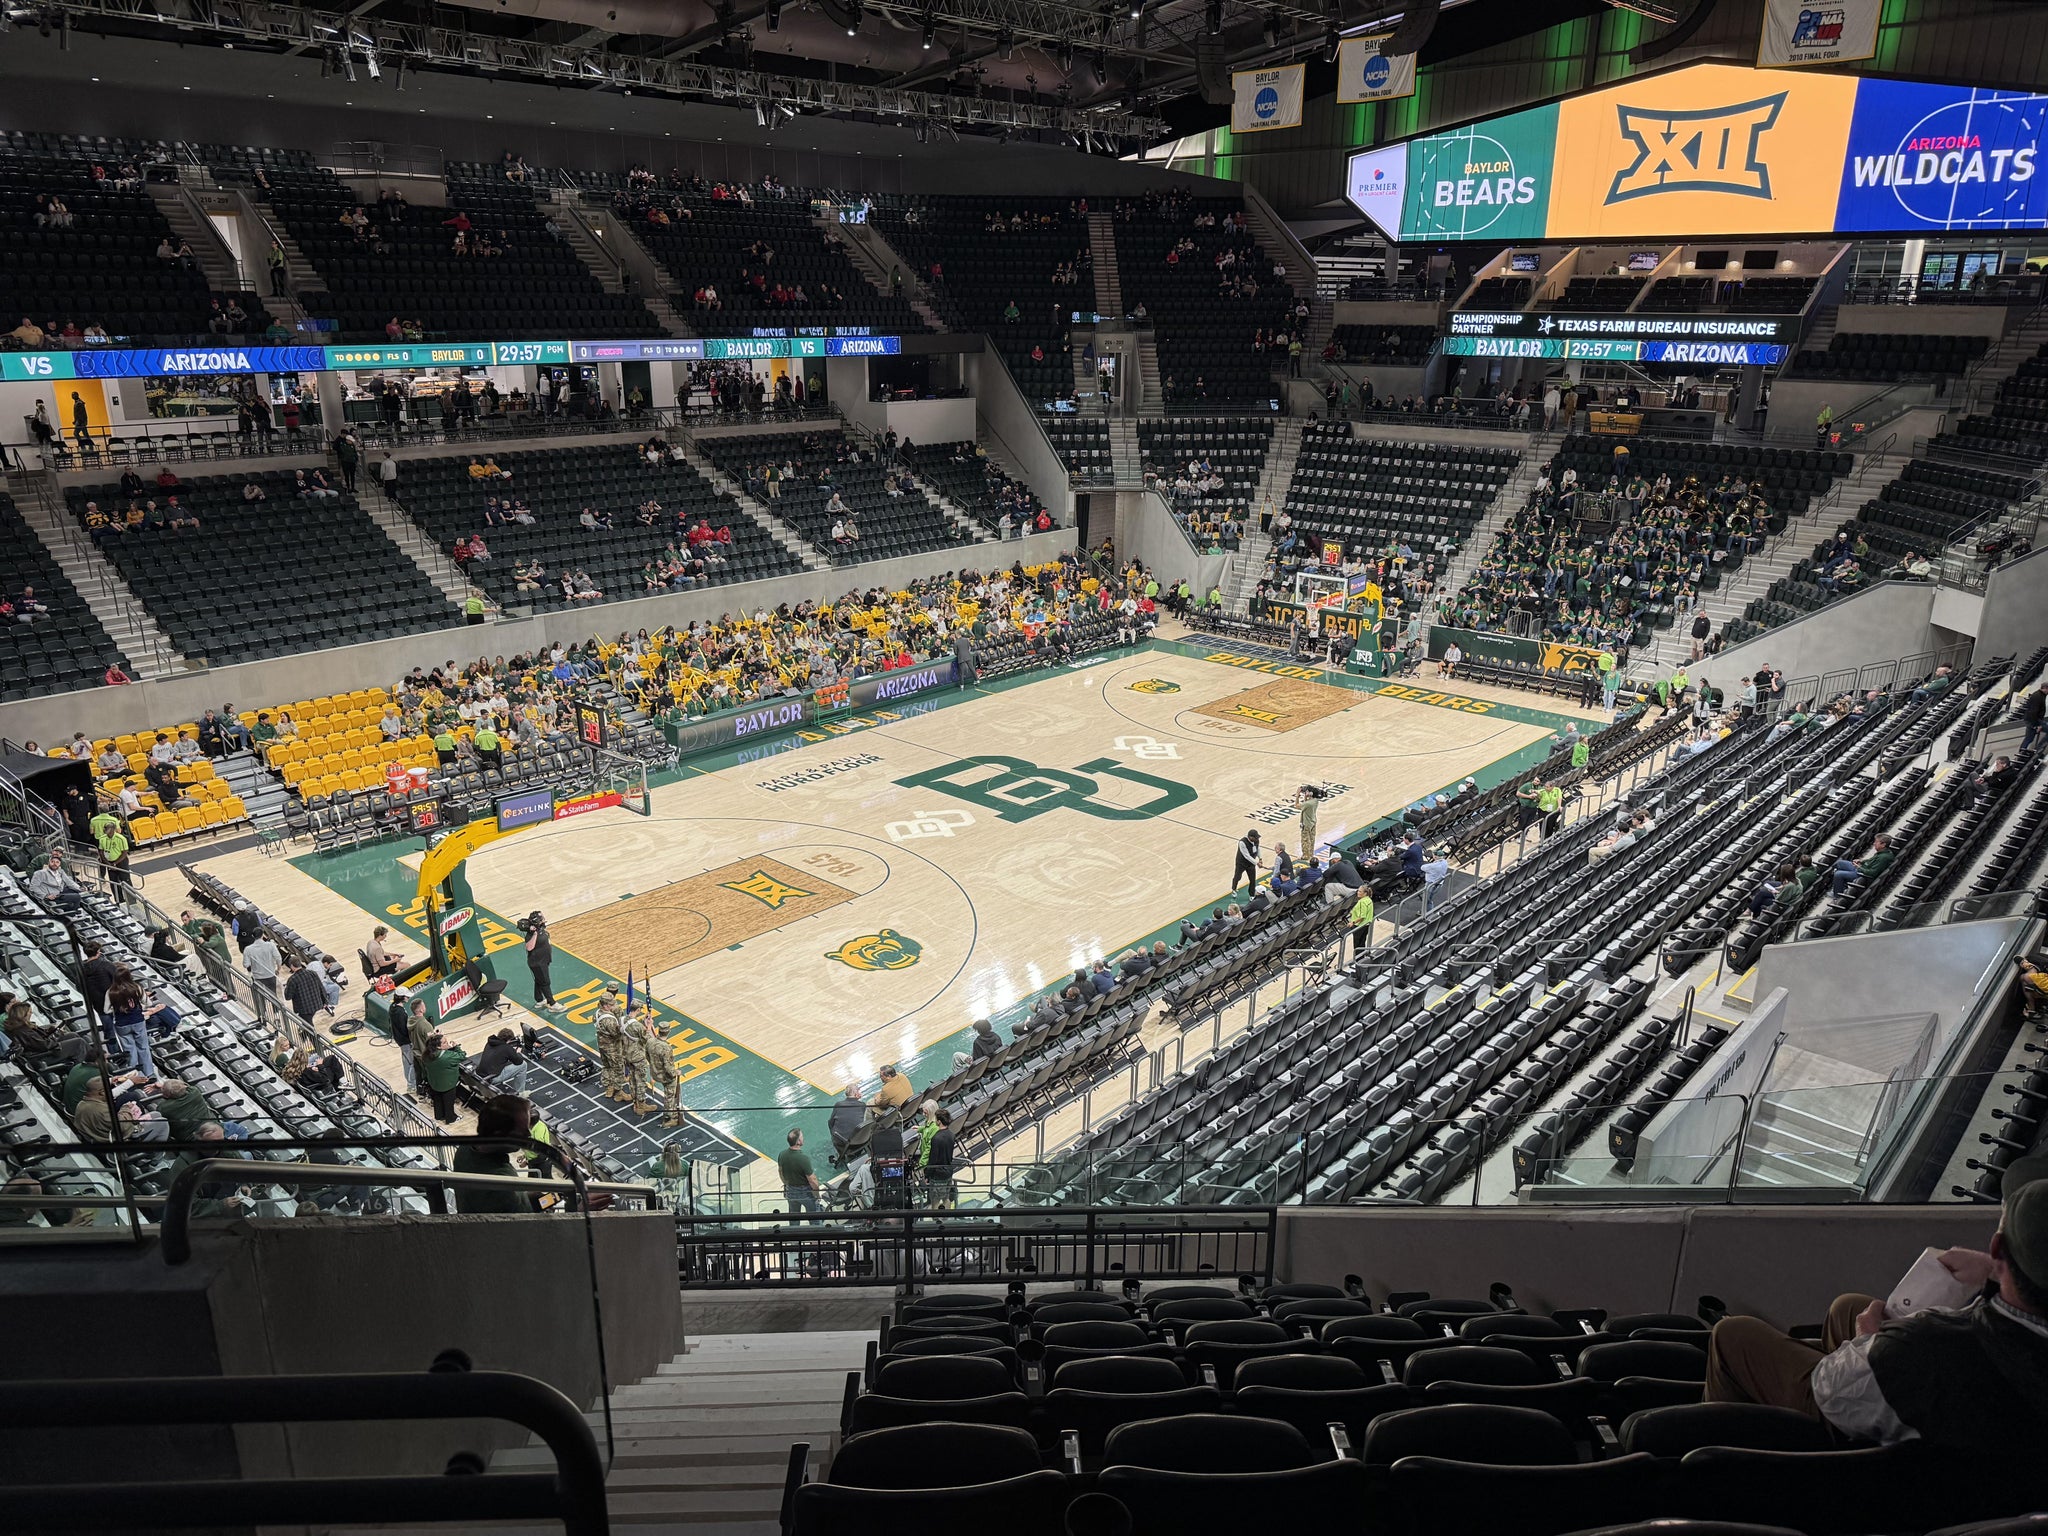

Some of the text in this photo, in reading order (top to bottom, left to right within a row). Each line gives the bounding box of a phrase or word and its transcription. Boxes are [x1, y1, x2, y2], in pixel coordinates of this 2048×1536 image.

[1789, 51, 1840, 61] 2010 FINAL FOUR
[1255, 71, 1280, 83] BAYLOR
[1365, 70, 1389, 81] NCAA
[1367, 90, 1380, 98] FINAL
[1380, 88, 1392, 97] FOUR
[1257, 101, 1277, 112] NCAA
[1259, 120, 1270, 128] FINAL
[1270, 119, 1280, 127] FOUR
[1906, 135, 1982, 152] ARIZONA
[1464, 161, 1511, 174] BAYLOR
[1854, 148, 2035, 188] WILDCATS
[1358, 183, 1398, 192] PREMIER
[1434, 176, 1536, 207] BEARS
[1453, 314, 1523, 324] CHAMPIONSHIP
[1452, 324, 1494, 334] PARTNER
[1557, 320, 1777, 335] TEXAS FARM BUREAU INSURANCE
[402, 351, 409, 361] 0
[431, 349, 465, 362] BAYLOR
[476, 349, 484, 360] 0
[499, 345, 564, 362] 29:57 PGM
[581, 346, 587, 357] 0
[727, 340, 885, 356] BAYLOR VS ARIZONA
[1476, 339, 1749, 364] BAYLOR 29:57 PGM ARIZONA
[21, 356, 53, 375] VS
[163, 352, 251, 371] ARIZONA
[1203, 652, 1324, 680] BAYLOR
[875, 669, 938, 699] ARIZONA
[1375, 684, 1497, 714] BEARS
[735, 703, 802, 736] BAYLOR
[1197, 719, 1247, 734] 1845
[755, 772, 803, 789] MARK
[819, 752, 871, 769] PAULA
[762, 755, 886, 793] HURD FLOOR
[890, 755, 1199, 824] BU
[411, 800, 438, 815] 29:57
[1243, 801, 1284, 820] MARK
[418, 813, 433, 825] 30
[803, 853, 866, 878] 1845
[439, 909, 472, 937] LIBMAN
[438, 980, 474, 1019] LIBMA
[545, 1090, 557, 1099] B-3
[565, 1104, 578, 1112] B-4
[586, 1118, 600, 1127] B-5
[608, 1132, 622, 1141] B-6
[680, 1137, 694, 1146] A-8
[355, 1198, 383, 1210] 116
